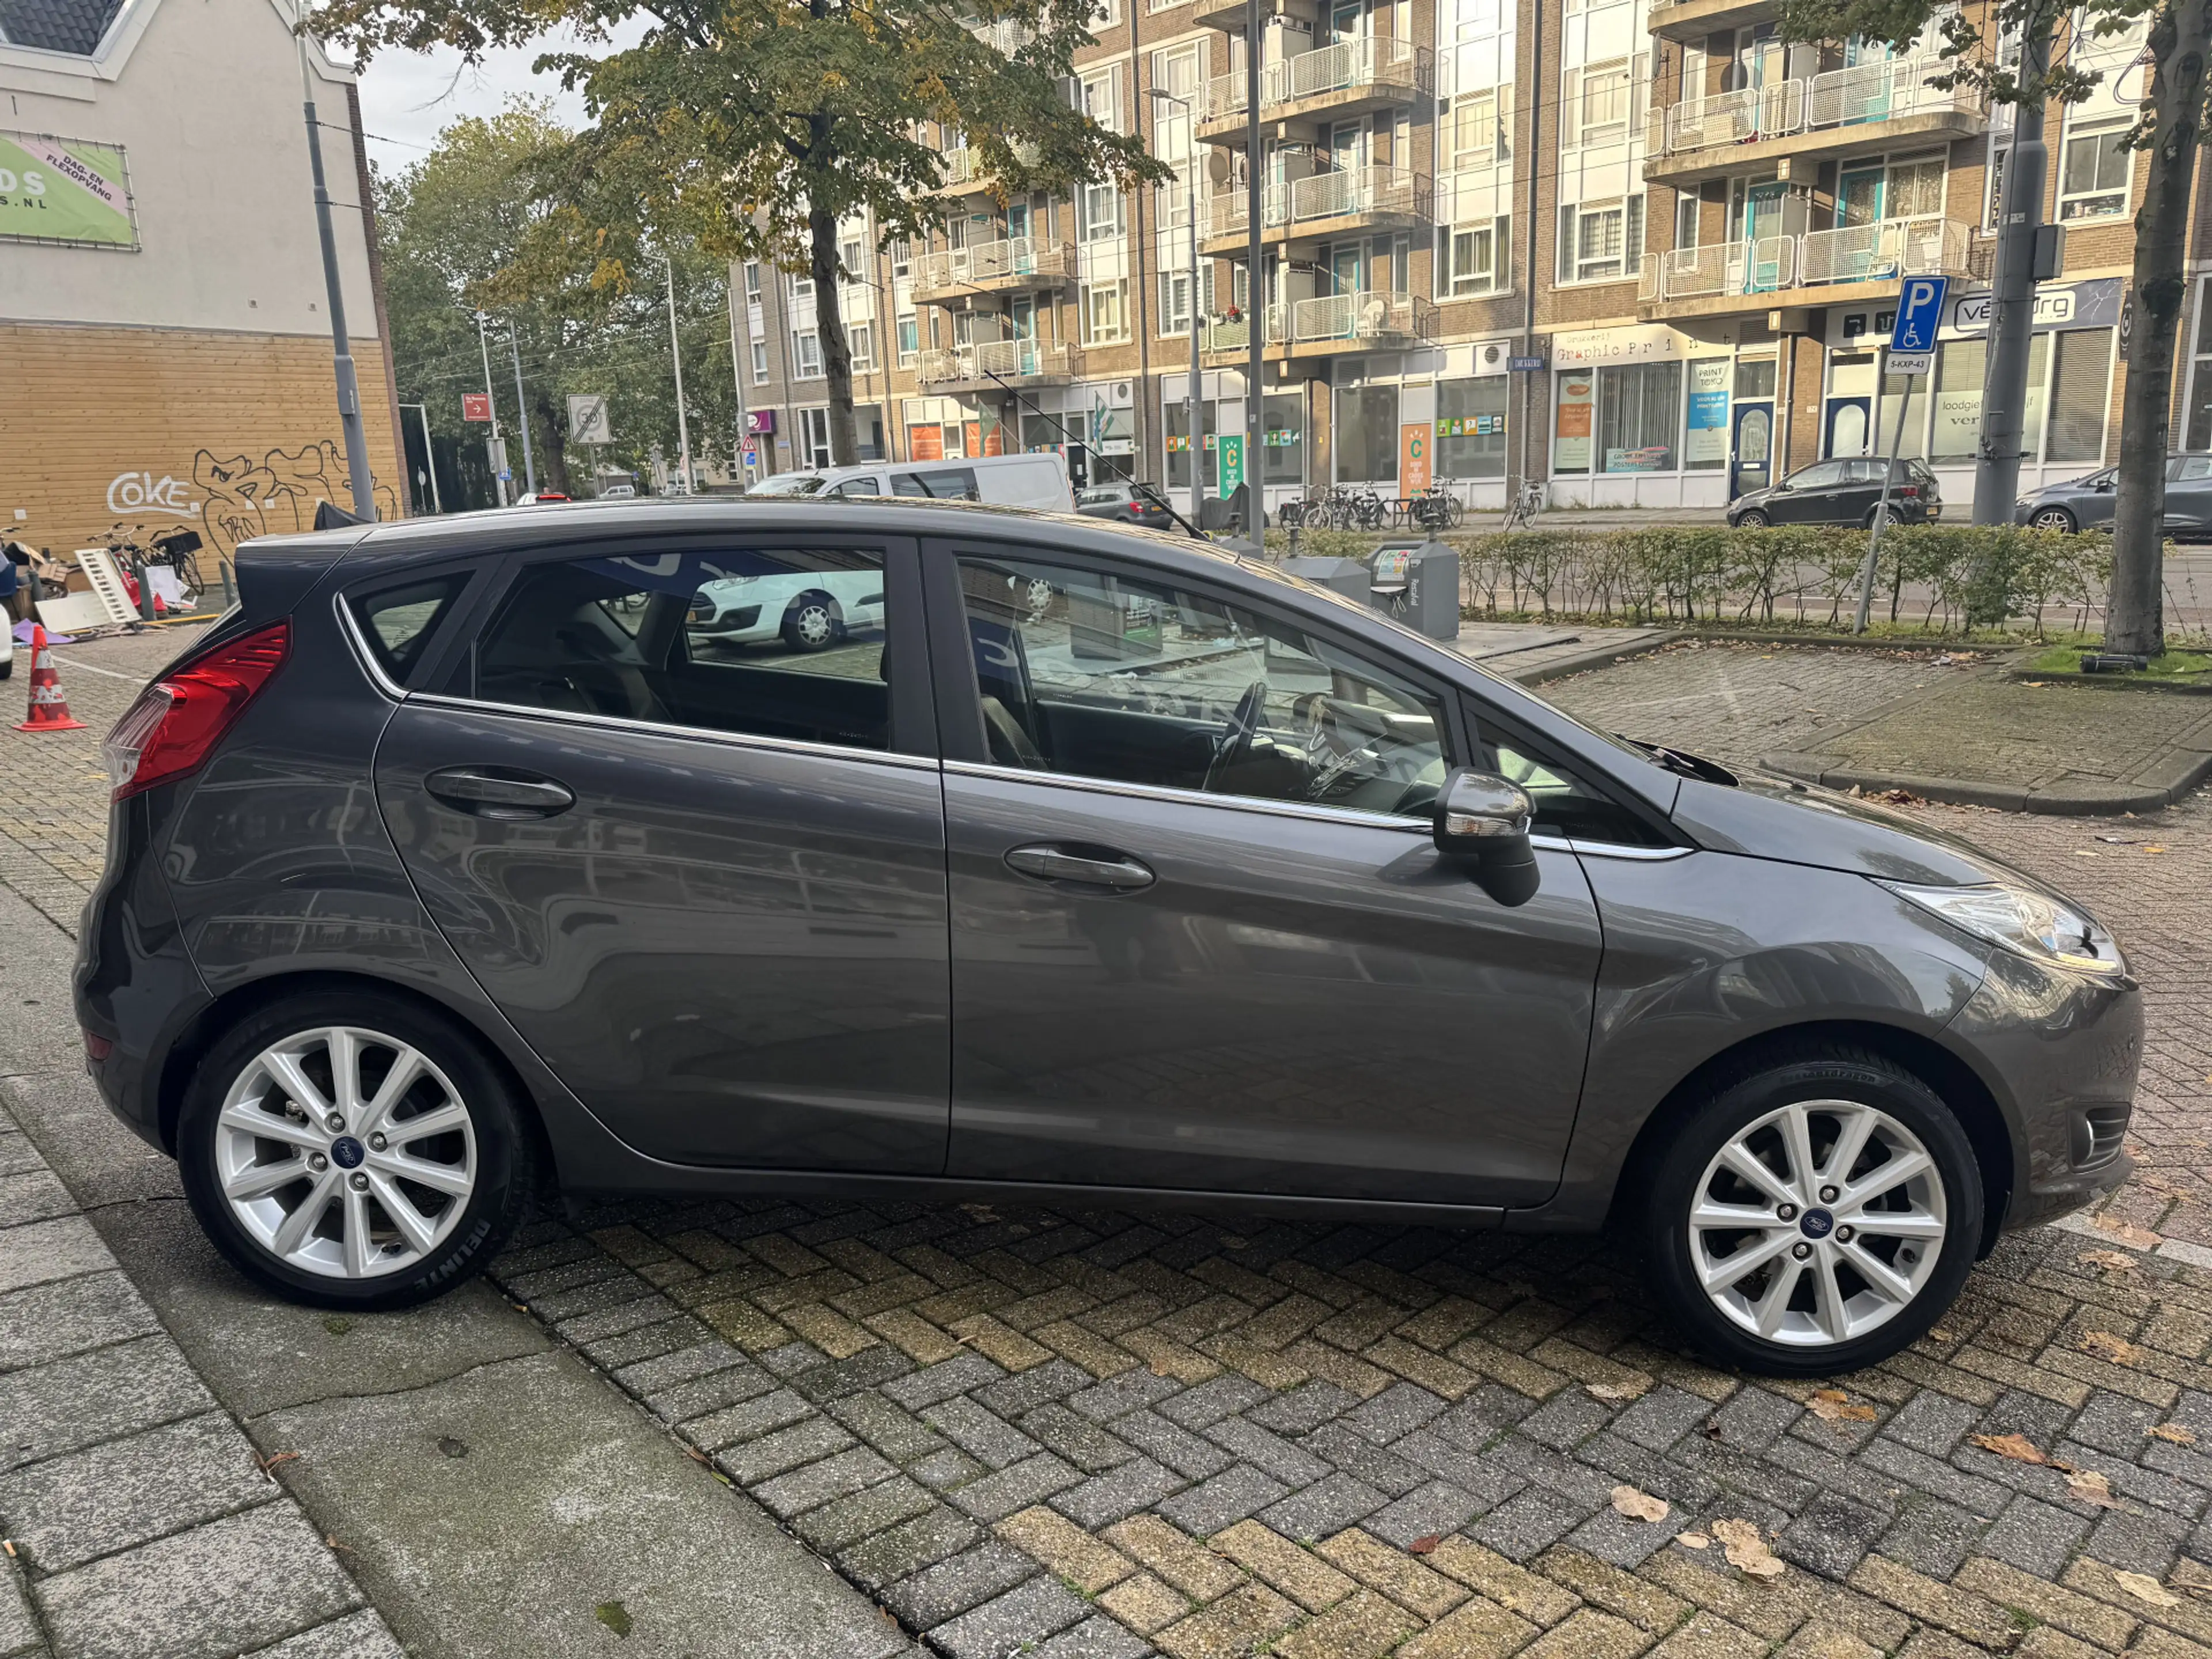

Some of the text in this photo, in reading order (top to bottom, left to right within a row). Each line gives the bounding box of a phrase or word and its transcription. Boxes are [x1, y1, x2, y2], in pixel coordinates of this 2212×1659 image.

[46, 154, 112, 201] FLEXOPVANG
[63, 156, 104, 186] DAG- EN
[1906, 282, 1935, 320] P
[1557, 333, 1731, 361] Graphic Print
[1699, 367, 1723, 377] PRINT
[1890, 360, 1925, 369] 5-KXP-43
[107, 471, 195, 515] COKE
[413, 1217, 492, 1292] DELINTE
